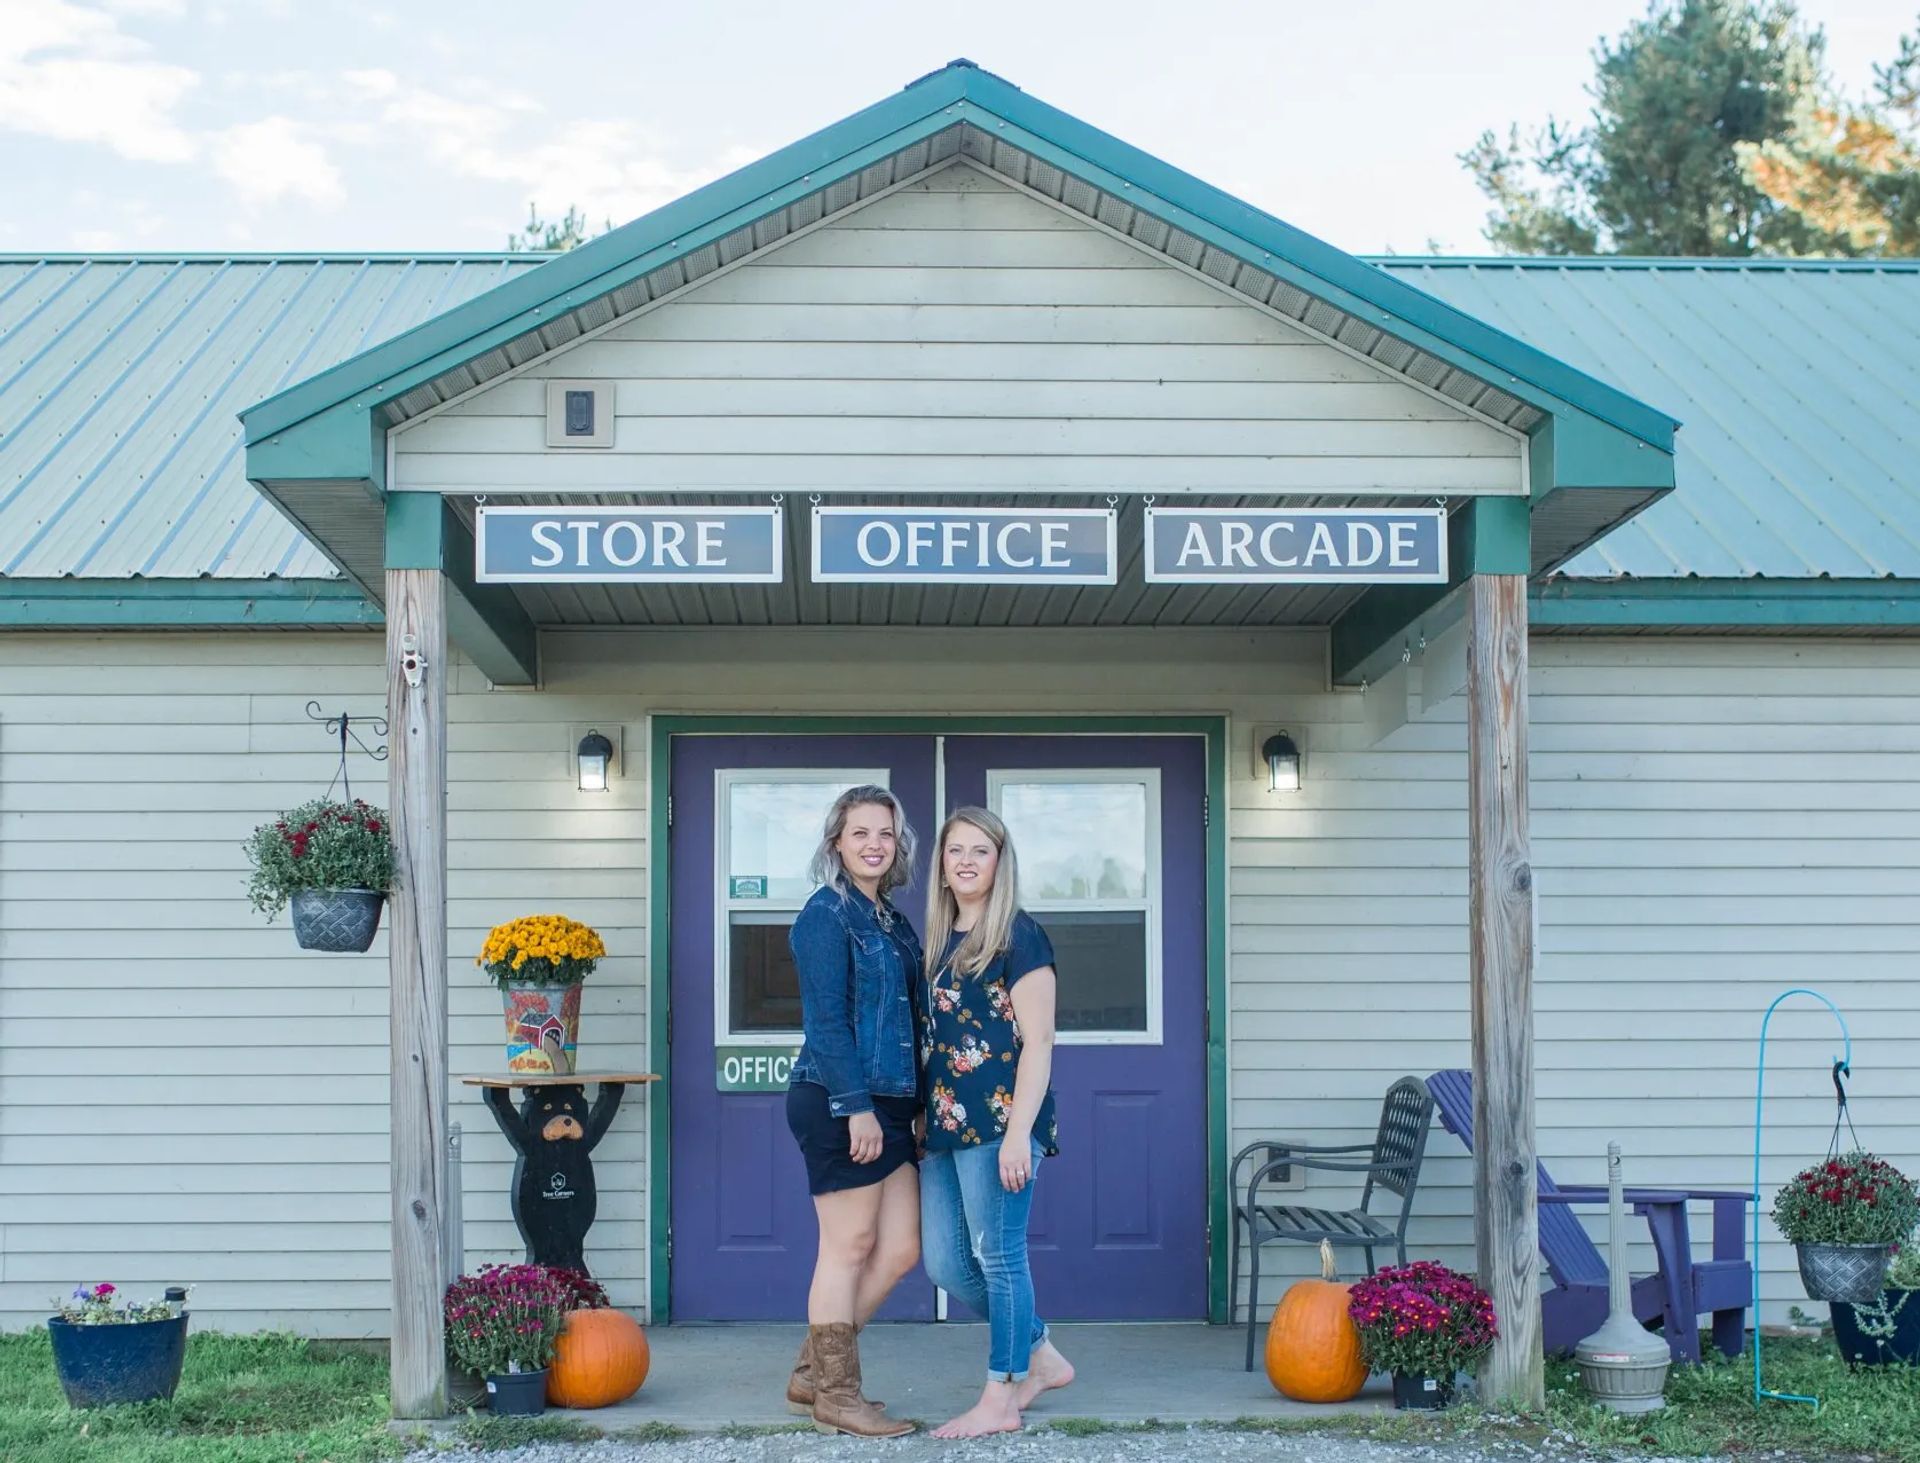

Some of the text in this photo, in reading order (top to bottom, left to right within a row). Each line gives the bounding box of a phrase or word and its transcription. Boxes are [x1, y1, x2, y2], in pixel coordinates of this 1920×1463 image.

[530, 520, 728, 568] STORE
[856, 521, 1072, 569] OFFICE
[1176, 521, 1420, 569] ARCADE
